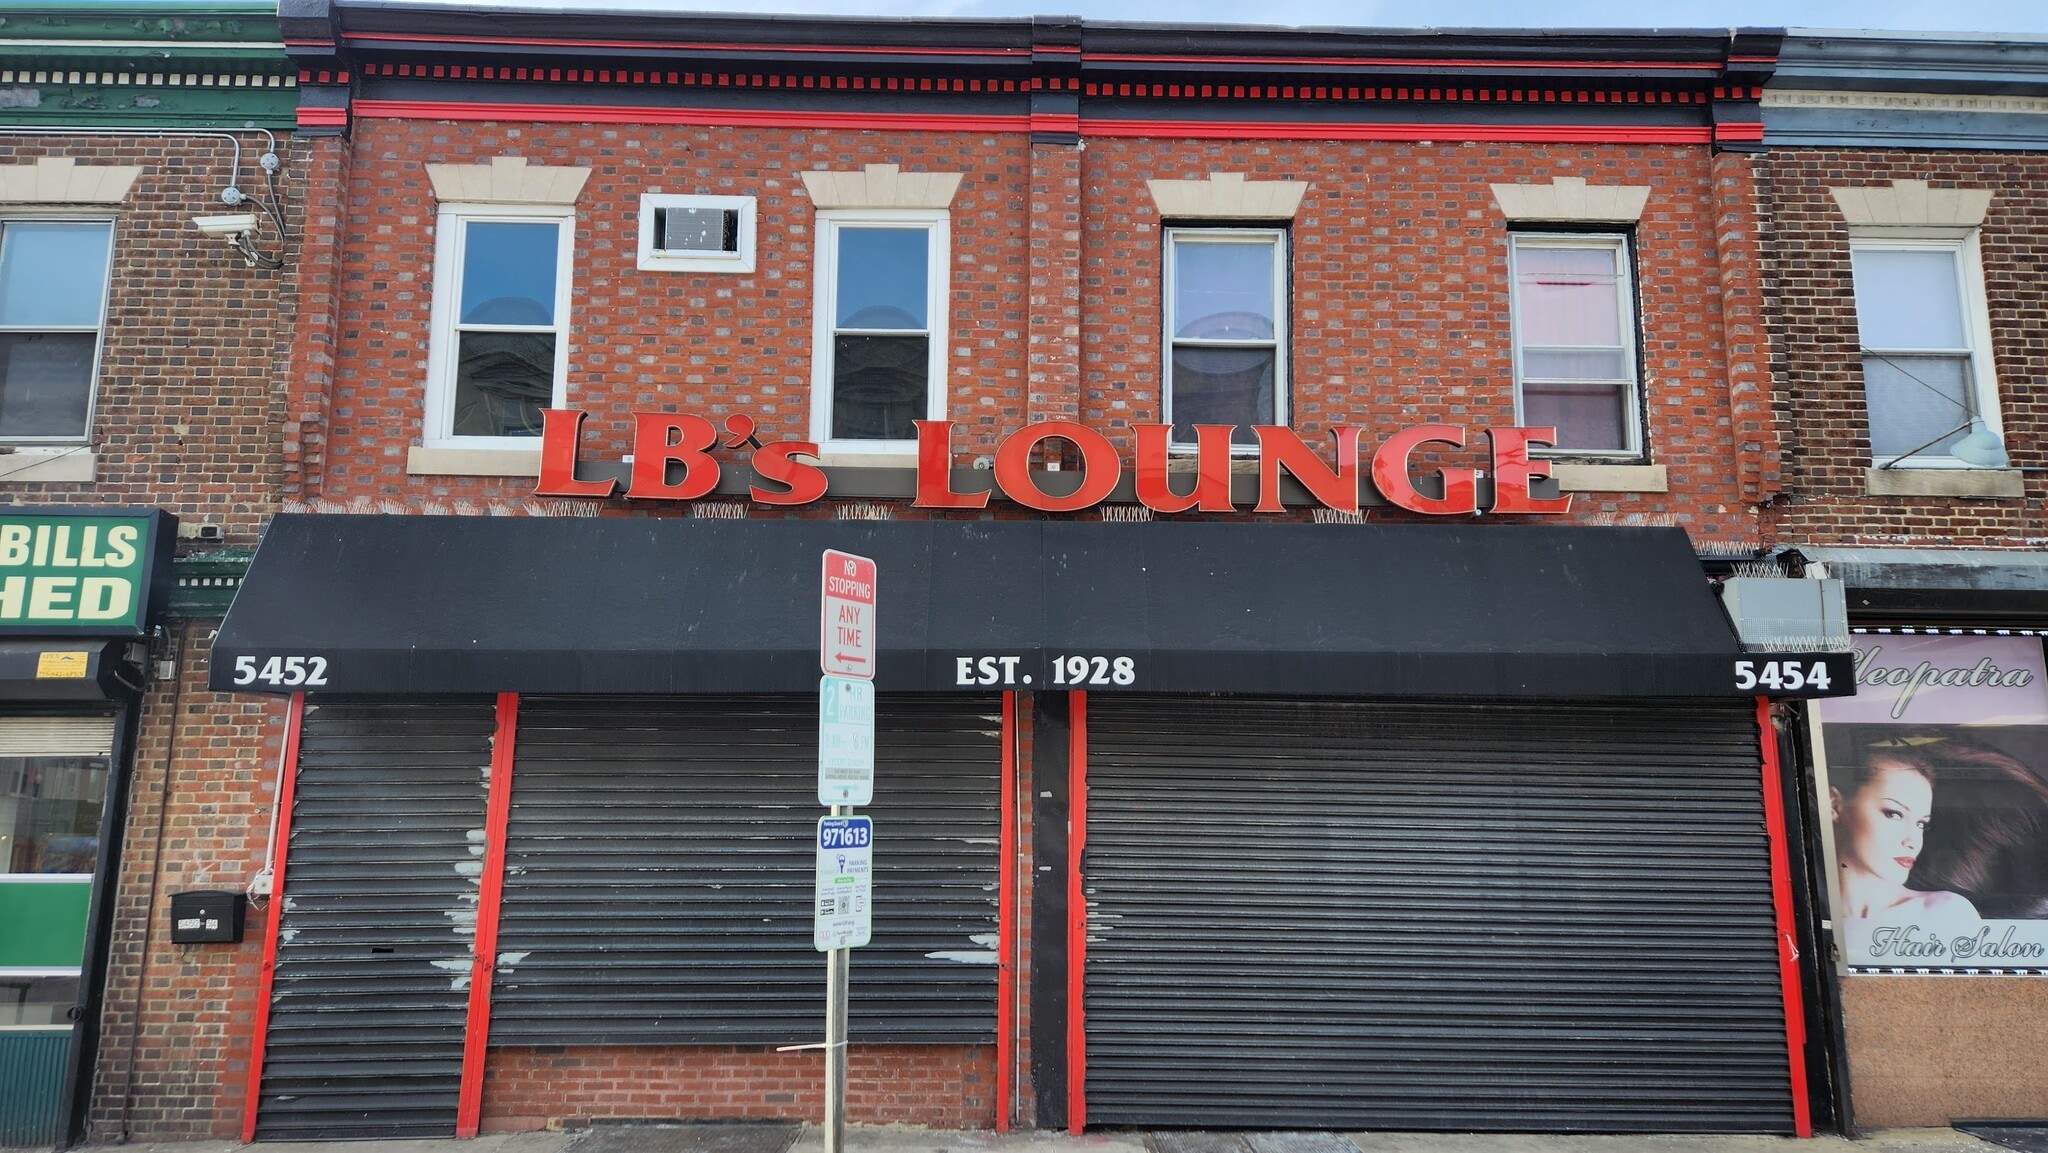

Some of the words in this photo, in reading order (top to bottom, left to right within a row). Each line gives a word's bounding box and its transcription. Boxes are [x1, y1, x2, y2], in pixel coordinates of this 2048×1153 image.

[910, 418, 1575, 517] LOUNGE
[0, 524, 138, 568] BILLS
[844, 560, 857, 577] NO
[828, 576, 871, 599] STOPPING
[838, 605, 861, 625] ANY
[837, 626, 862, 648] TIME
[233, 655, 328, 686] 5452
[956, 656, 1032, 686] EST.
[1052, 656, 1136, 685] 1928
[1735, 661, 1831, 690] 5454
[826, 685, 836, 716] 2
[839, 703, 871, 721] PARKING
[823, 827, 868, 847] 971613
[846, 866, 869, 874] PAYMENTS
[848, 859, 868, 867] PARKING
[1869, 925, 1946, 957] Hair
[1950, 925, 2045, 962] Salon
